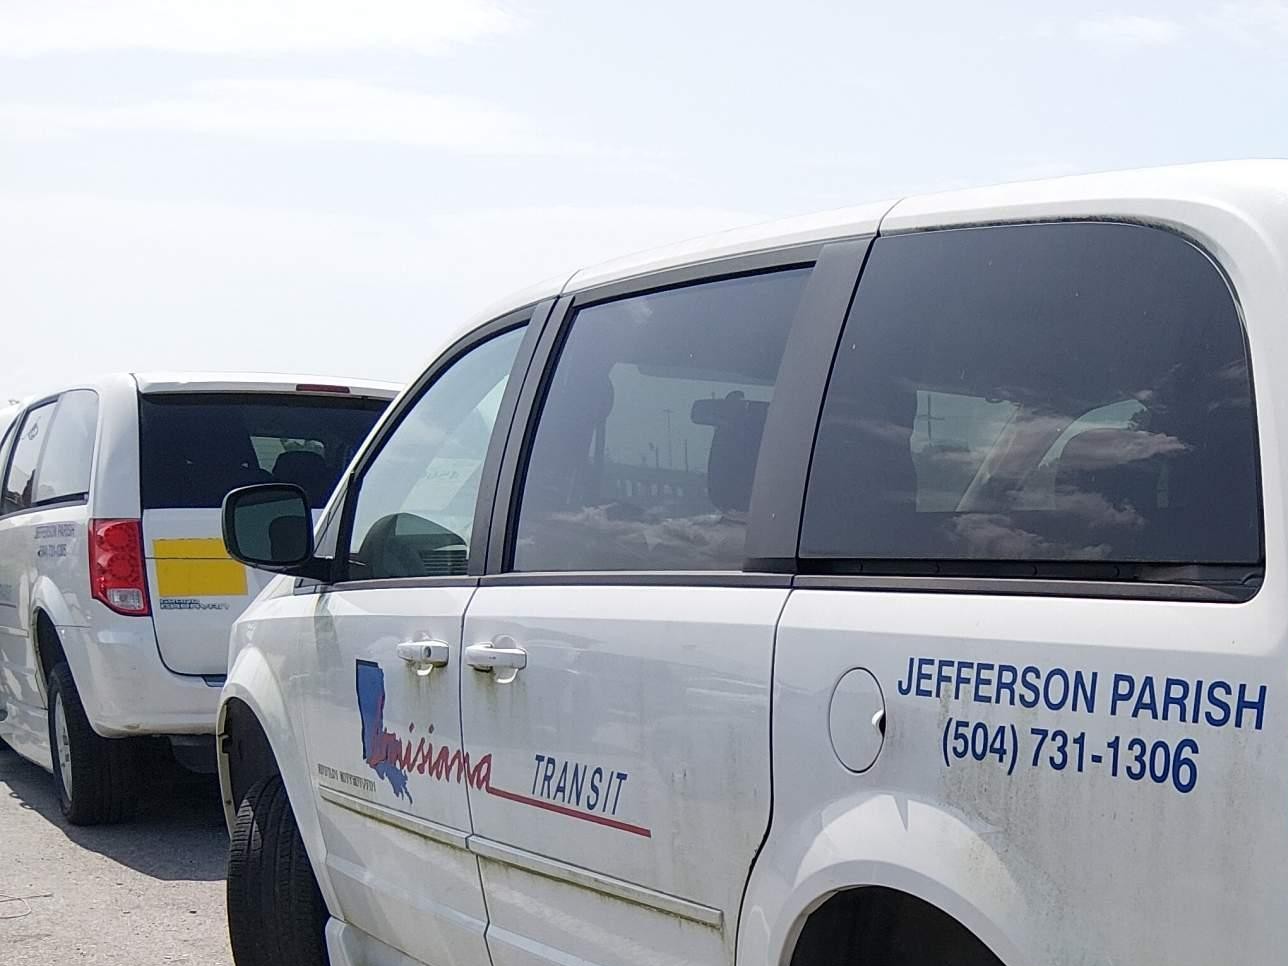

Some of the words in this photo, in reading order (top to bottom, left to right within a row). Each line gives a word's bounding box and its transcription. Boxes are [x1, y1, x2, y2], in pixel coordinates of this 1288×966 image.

[897, 657, 1098, 713] JEFFERSON
[1110, 673, 1268, 730] PARISH
[532, 753, 628, 816] TRANSIT
[943, 717, 1018, 775] (504)
[1030, 728, 1199, 794] 731-1306
